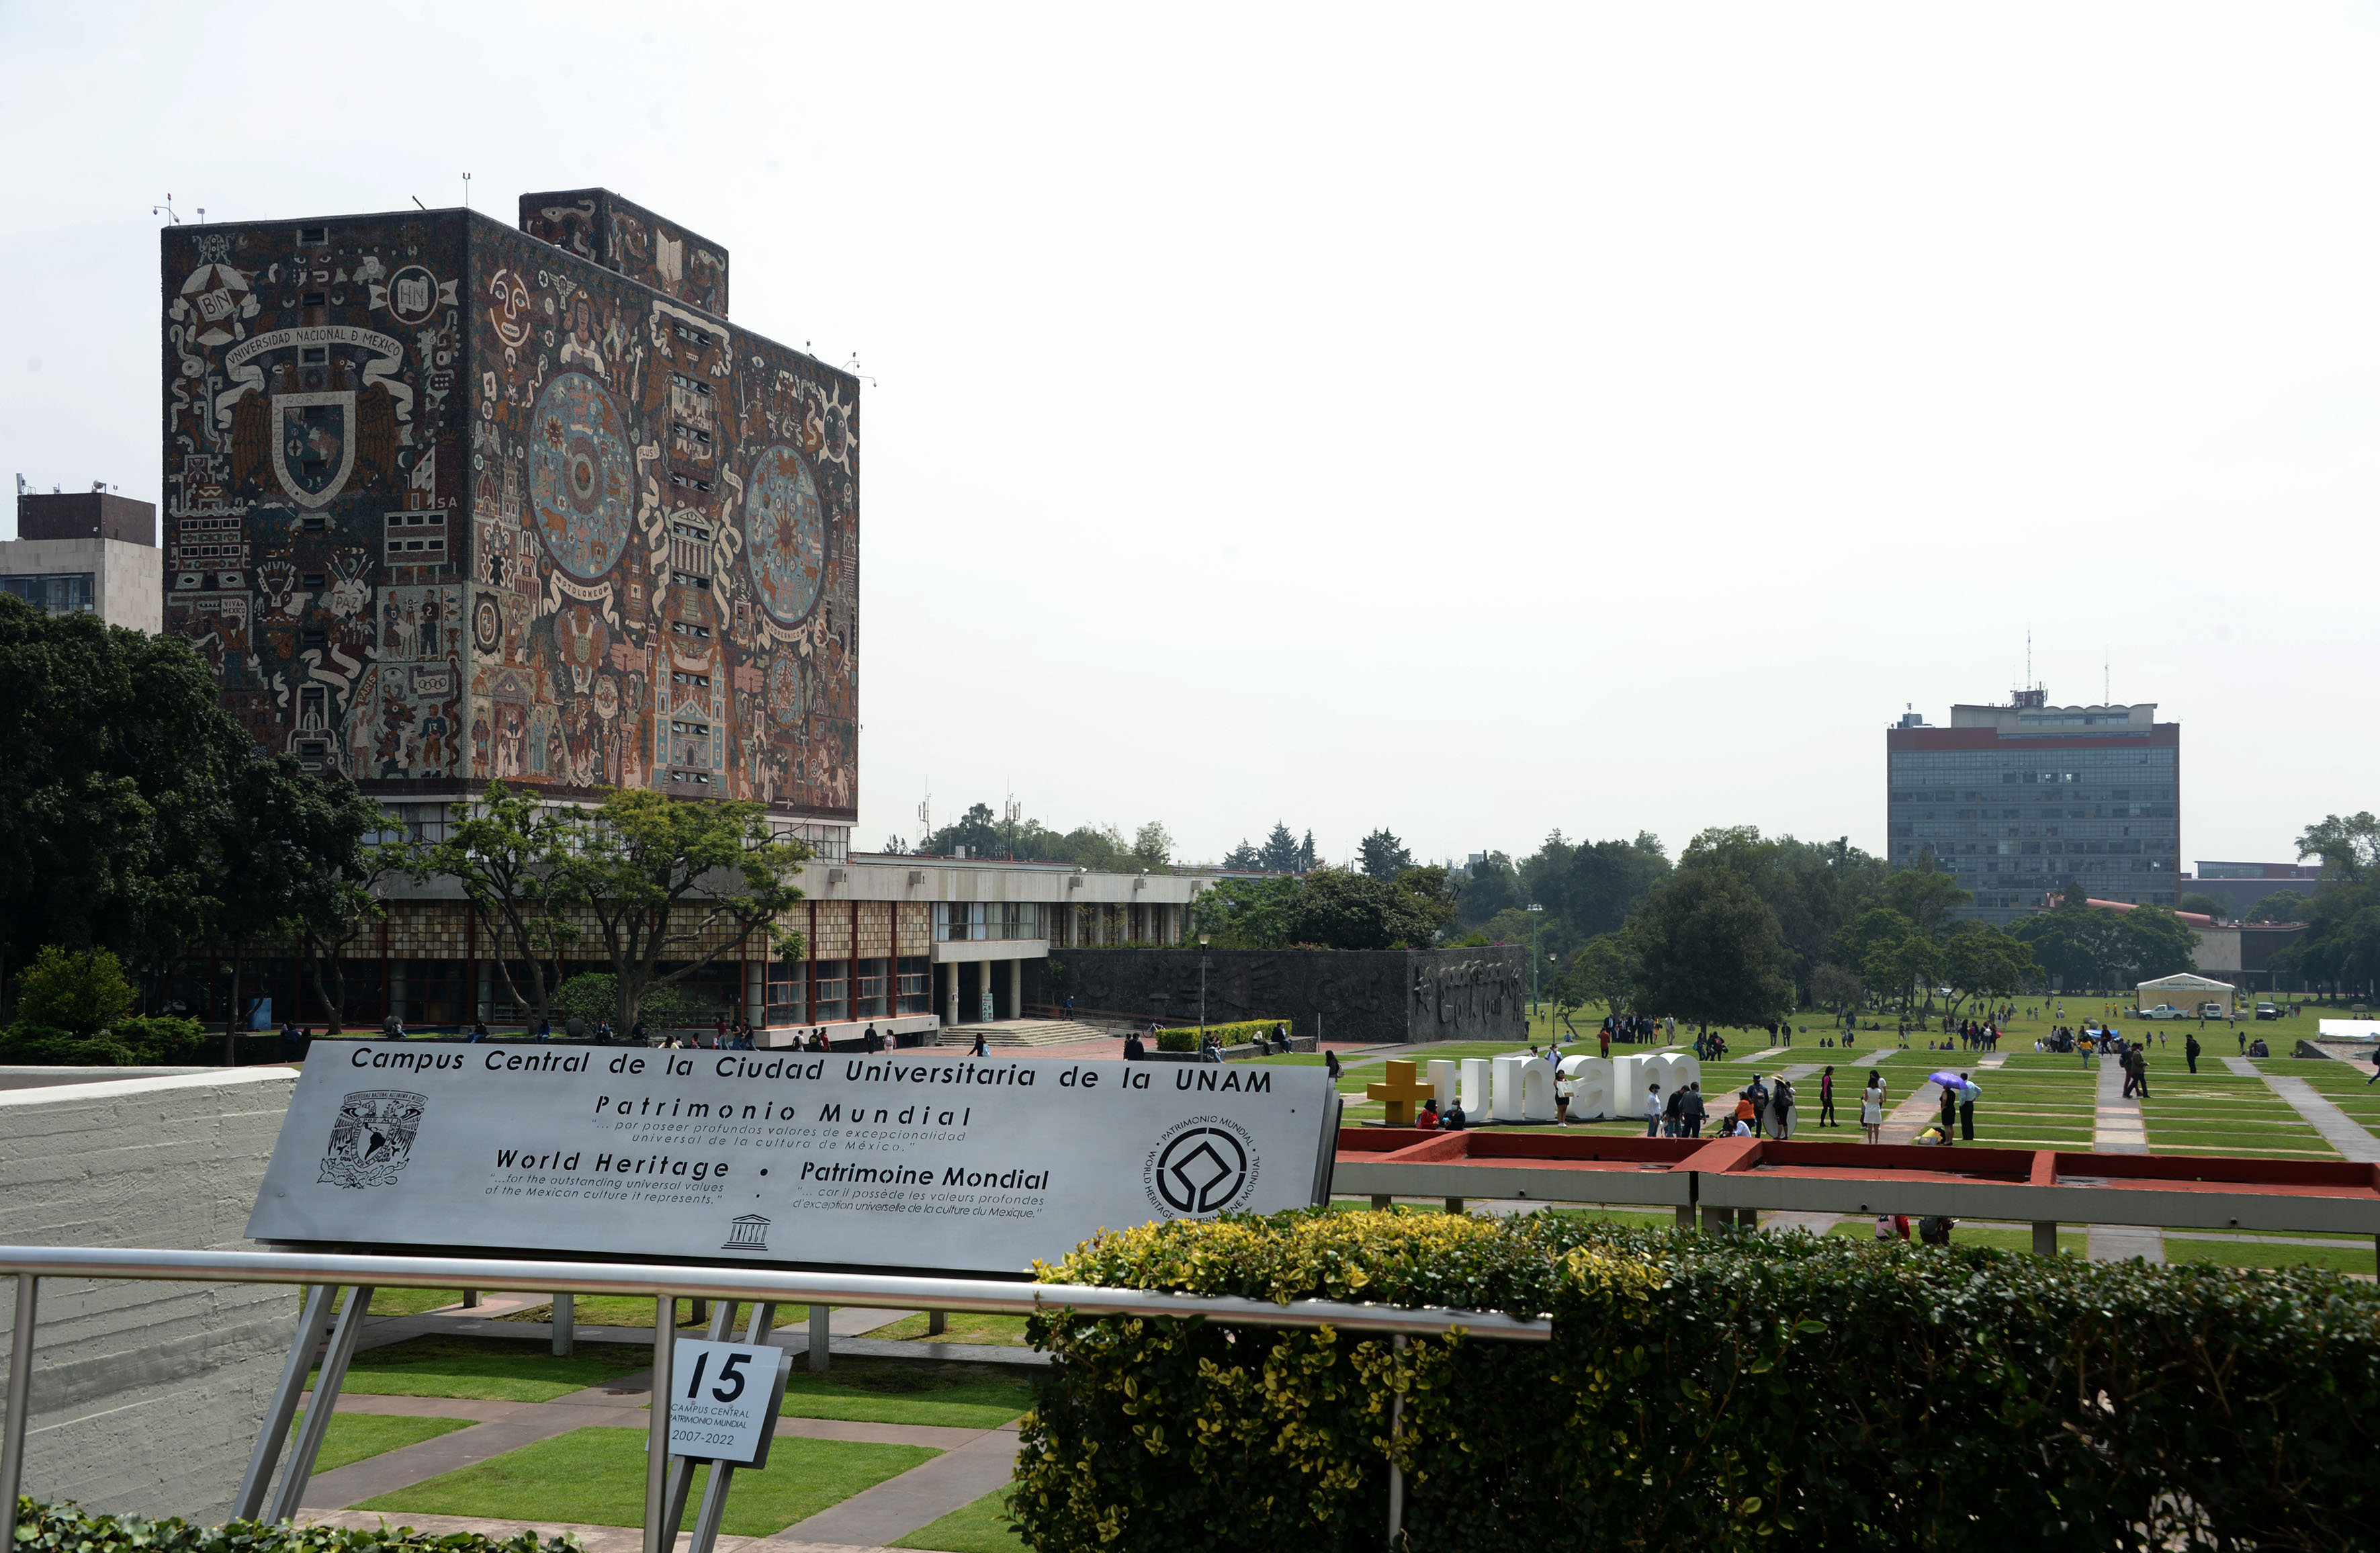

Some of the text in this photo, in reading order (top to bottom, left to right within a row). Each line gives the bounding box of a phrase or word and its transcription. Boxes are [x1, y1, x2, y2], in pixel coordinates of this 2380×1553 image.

[204, 289, 231, 314] BN
[401, 287, 425, 305] HN
[296, 328, 346, 341] NACIONAL
[363, 332, 400, 356] MEXICO
[640, 449, 653, 457] PLUS
[563, 581, 603, 597] PTOLOMEO
[336, 595, 358, 609] PAZ
[359, 674, 377, 703] PARIS
[351, 1048, 1270, 1093] Campus Central de la Ciudad Universitaria de la UNAM
[596, 1096, 970, 1126] Patrimonio Mundial
[615, 1122, 638, 1130] por
[642, 1123, 689, 1132] poseer
[693, 1124, 762, 1134] profundos
[769, 1126, 816, 1136] valores
[823, 1128, 839, 1137] de
[846, 1130, 965, 1141] excepcionalidad
[1161, 1116, 1254, 1147] PATRIMONIO MUNDIAL
[632, 1134, 701, 1144] universal
[709, 1136, 725, 1145] de
[734, 1137, 748, 1145] la
[756, 1139, 810, 1148] cultura
[819, 1140, 836, 1149] de
[497, 1149, 728, 1181] World Heritage
[527, 1174, 545, 1184] the
[550, 1177, 623, 1189] outstanding
[627, 1180, 681, 1190] universal
[686, 1182, 723, 1192] values
[801, 1161, 1049, 1190] Patrimoine Mondial
[1241, 1156, 1260, 1201] MONDIAL
[486, 1186, 498, 1194] of
[502, 1186, 521, 1195] the
[526, 1188, 578, 1198] Mexican
[584, 1190, 627, 1200] culture
[632, 1191, 641, 1200] it
[1143, 1151, 1175, 1219] WORLD HERITAGE
[842, 1188, 849, 1197] il
[852, 1189, 904, 1199] possède
[909, 1190, 926, 1200] les
[931, 1193, 975, 1202] valeurs
[978, 1194, 1044, 1205] profondes
[793, 1199, 853, 1210] d'exception
[856, 1202, 906, 1212] universelle
[908, 1204, 922, 1212] de
[924, 1204, 934, 1213] la
[936, 1205, 970, 1215] culture
[973, 1206, 987, 1216] du
[730, 1225, 767, 1242] UNESCO
[687, 1351, 752, 1403] 15
[671, 1404, 749, 1418] CAMPUS CENTRAL
[714, 1419, 747, 1429] MUNDIAL
[672, 1429, 734, 1446] 2007-2022
